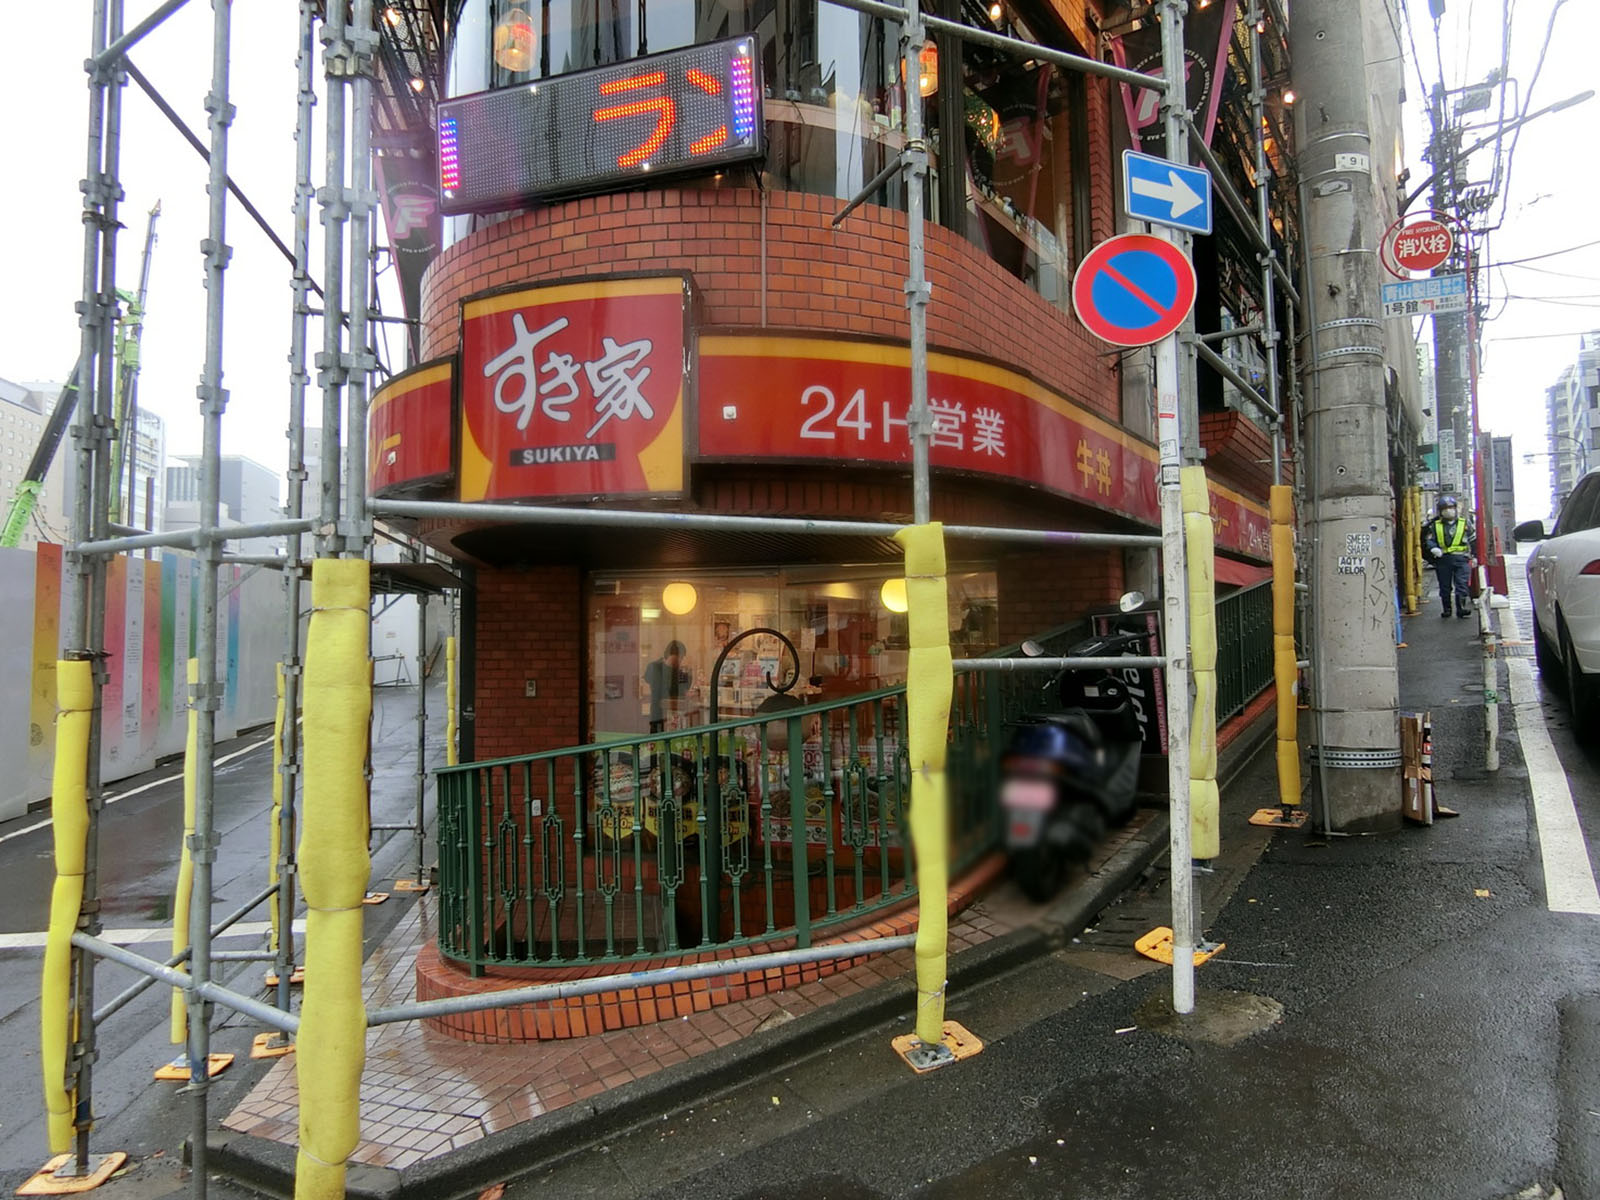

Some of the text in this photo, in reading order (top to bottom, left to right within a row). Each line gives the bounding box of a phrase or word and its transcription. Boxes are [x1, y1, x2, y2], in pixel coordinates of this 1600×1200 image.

[1398, 233, 1447, 258] 消火栓
[1385, 301, 1418, 315] 1号館
[484, 312, 654, 439] すき家
[523, 445, 599, 464] SUKIYA
[1076, 437, 1112, 496] 牛丼
